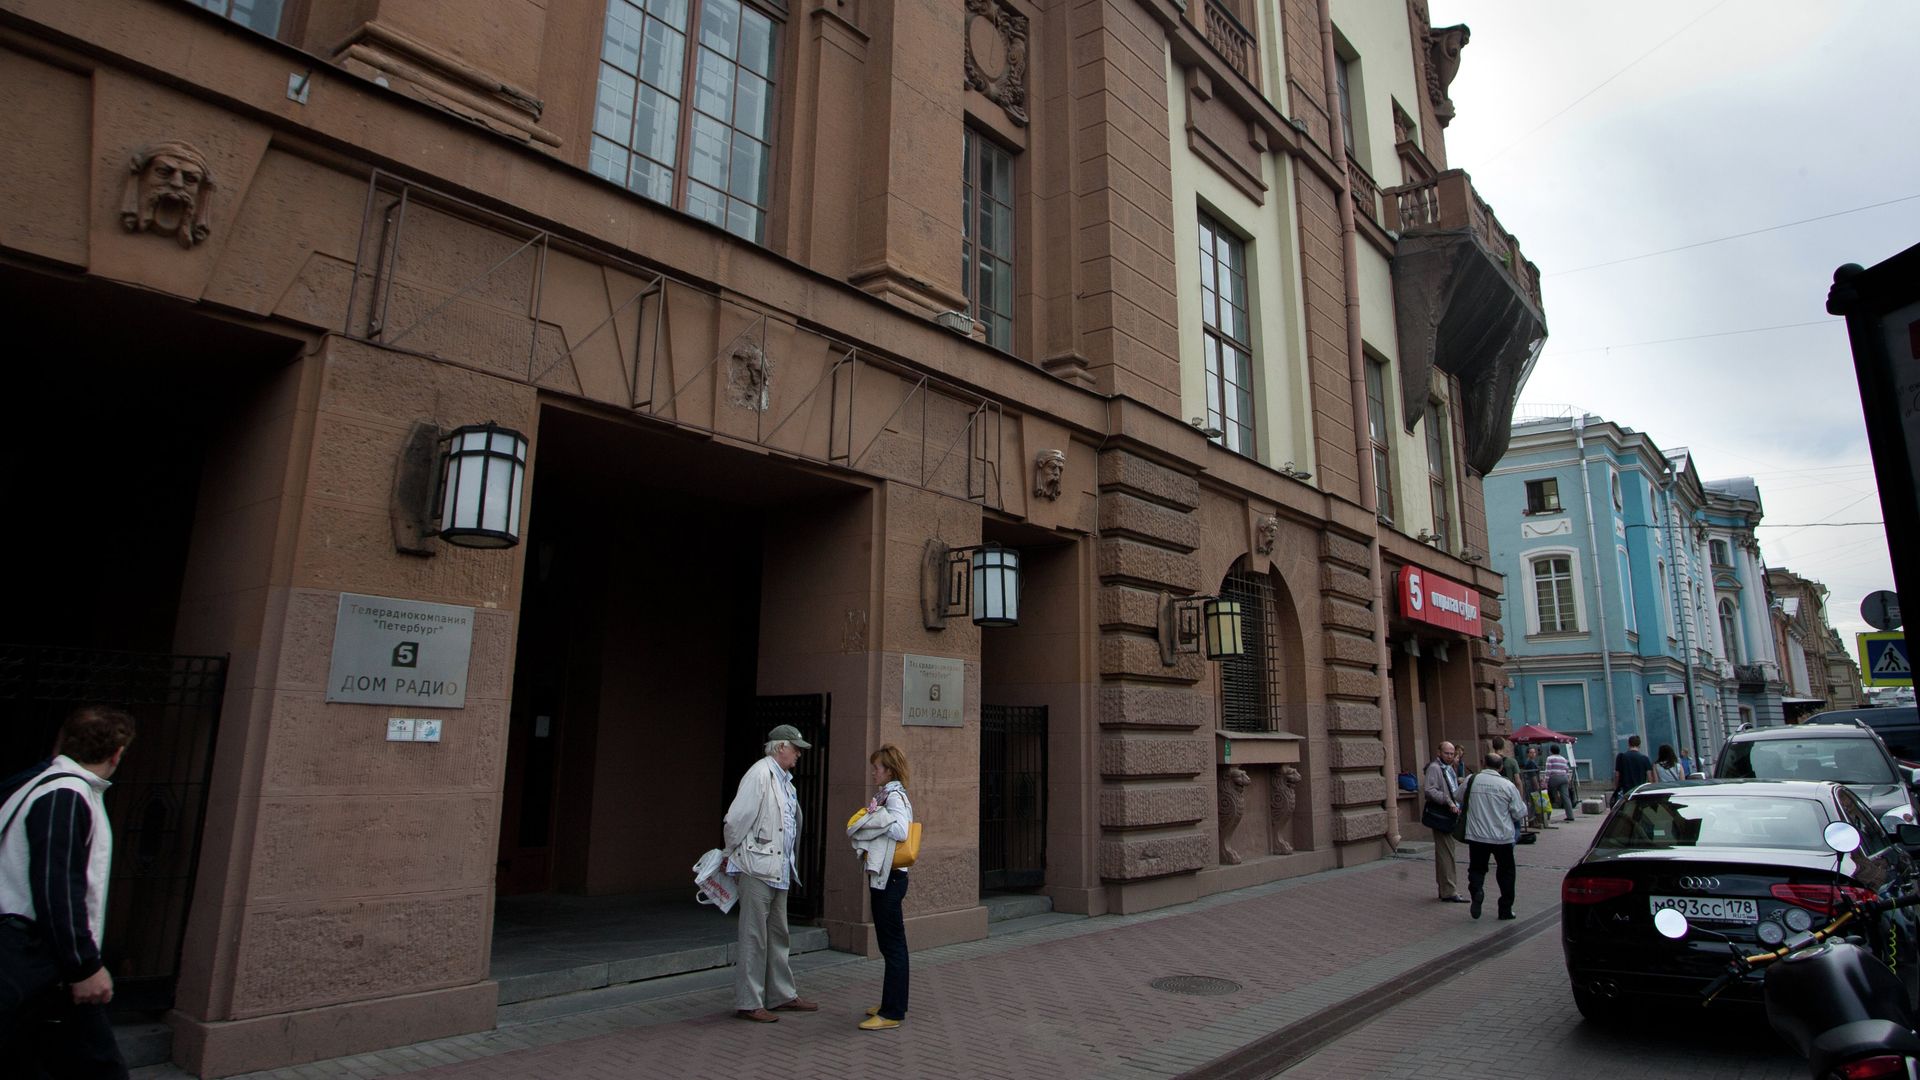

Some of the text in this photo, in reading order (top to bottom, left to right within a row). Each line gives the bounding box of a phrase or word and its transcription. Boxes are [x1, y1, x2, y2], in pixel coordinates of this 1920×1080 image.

[1409, 573, 1423, 611] 5
[351, 604, 467, 625] Телерадиокомпания
[341, 675, 458, 697] ДОМ РАДИО
[908, 706, 928, 719] ДОМ
[1726, 900, 1753, 914] 178
